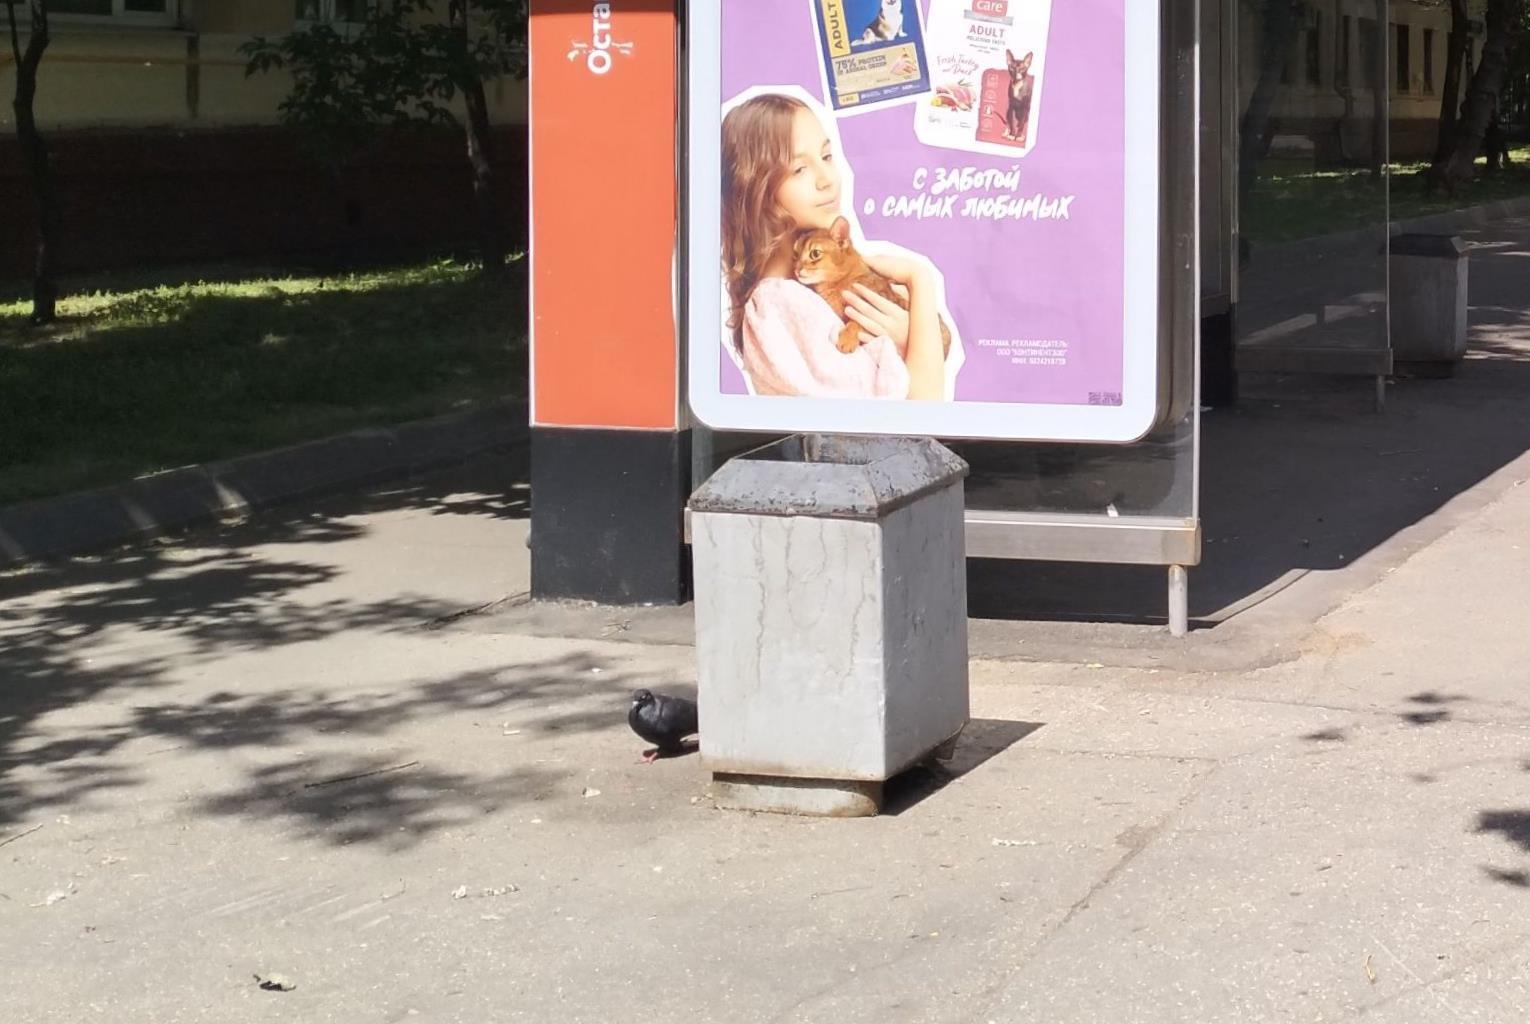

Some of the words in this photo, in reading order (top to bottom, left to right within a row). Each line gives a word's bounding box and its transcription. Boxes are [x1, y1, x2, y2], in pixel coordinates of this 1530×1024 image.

[976, 0, 1003, 13] care
[828, 2, 843, 50] ADULT
[969, 24, 1005, 38] ADULT
[912, 167, 927, 189] С
[882, 192, 959, 220] САМЫХ
[961, 193, 1075, 221] ЛЮБИМЫХ
